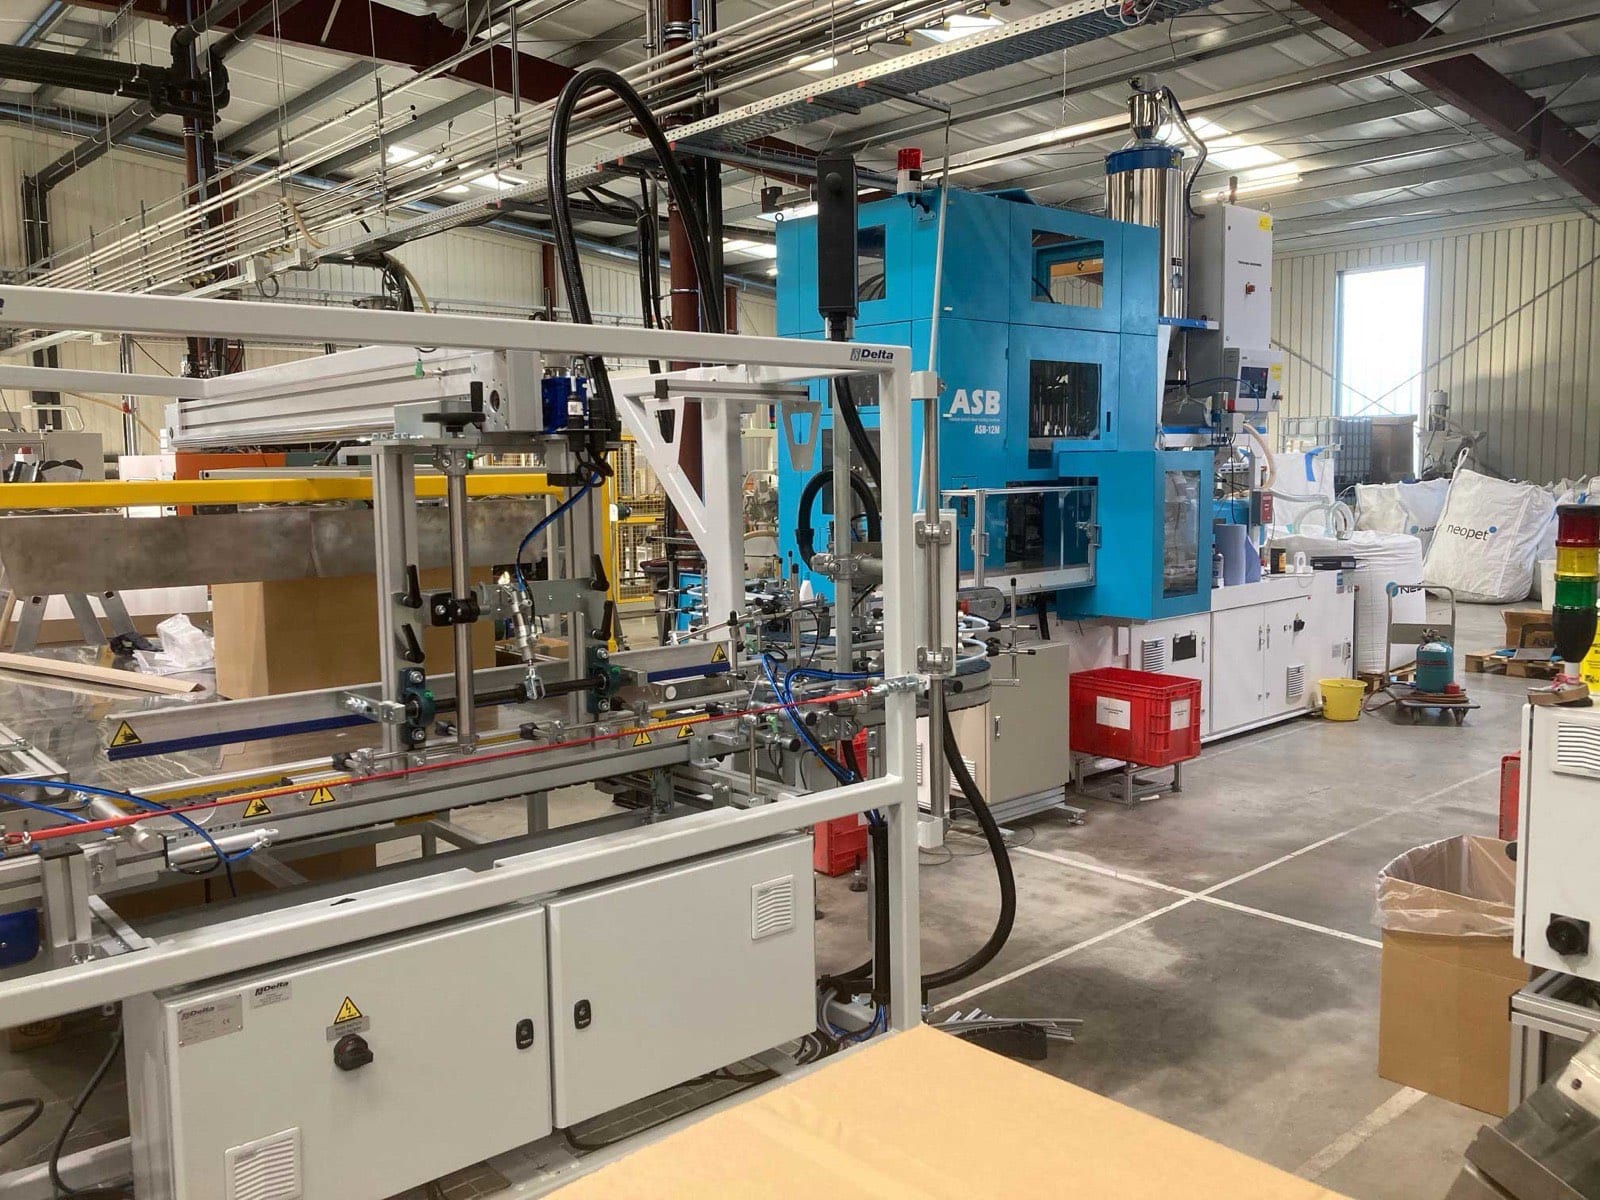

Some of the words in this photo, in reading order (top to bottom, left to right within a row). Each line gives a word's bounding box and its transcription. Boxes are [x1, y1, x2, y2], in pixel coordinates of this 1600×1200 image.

[861, 349, 894, 360] Delta
[949, 388, 1001, 415] ASB
[974, 424, 1001, 434] ASB-12M
[1446, 523, 1489, 541] neopet
[263, 981, 289, 992] Delta
[190, 1005, 215, 1016] Delta
